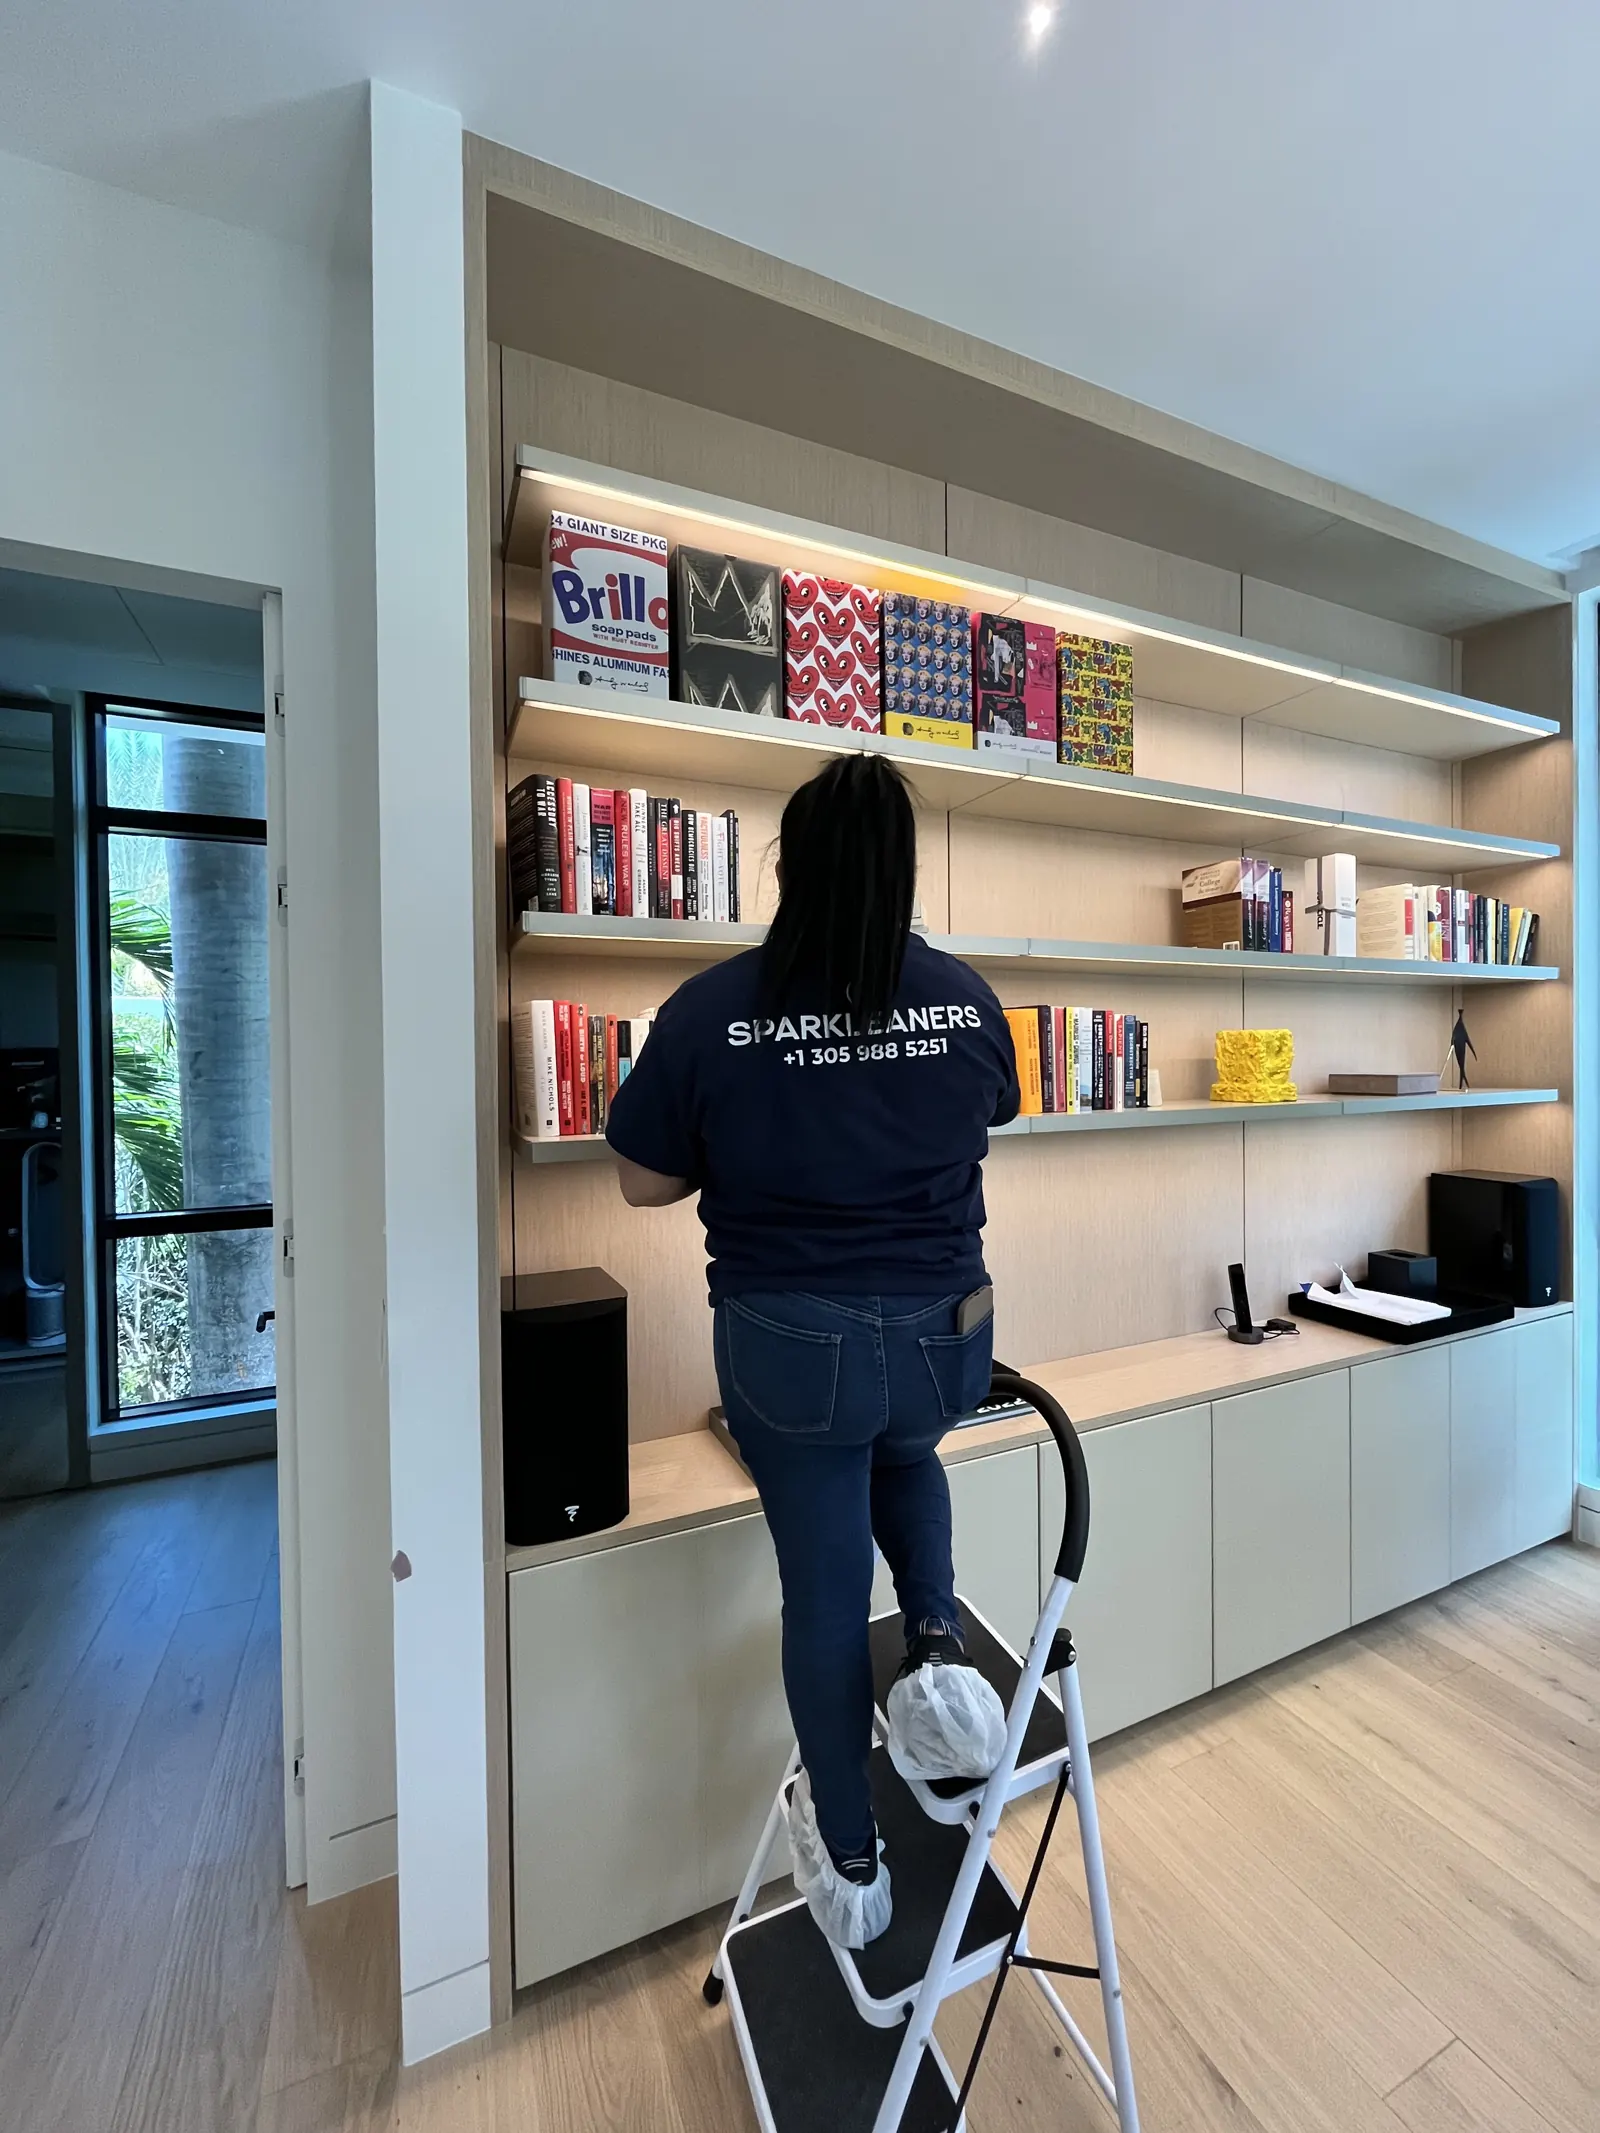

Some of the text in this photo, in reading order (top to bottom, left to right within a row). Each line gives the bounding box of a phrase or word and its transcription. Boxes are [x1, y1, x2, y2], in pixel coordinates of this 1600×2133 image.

[551, 533, 568, 550] ew!
[567, 517, 607, 537] GIANT
[610, 528, 639, 545] SIZE
[642, 535, 667, 551] PKG
[552, 569, 668, 630] Brillo
[591, 623, 657, 642] soap pads
[592, 656, 650, 676] ALUMINUM
[536, 788, 547, 817] TO WAR
[546, 780, 557, 828] ACCESSORY
[621, 824, 629, 857] RULES
[661, 821, 669, 846] GREAT
[662, 848, 670, 881] DISSENT
[784, 1037, 948, 1066] +1 305 988 5251
